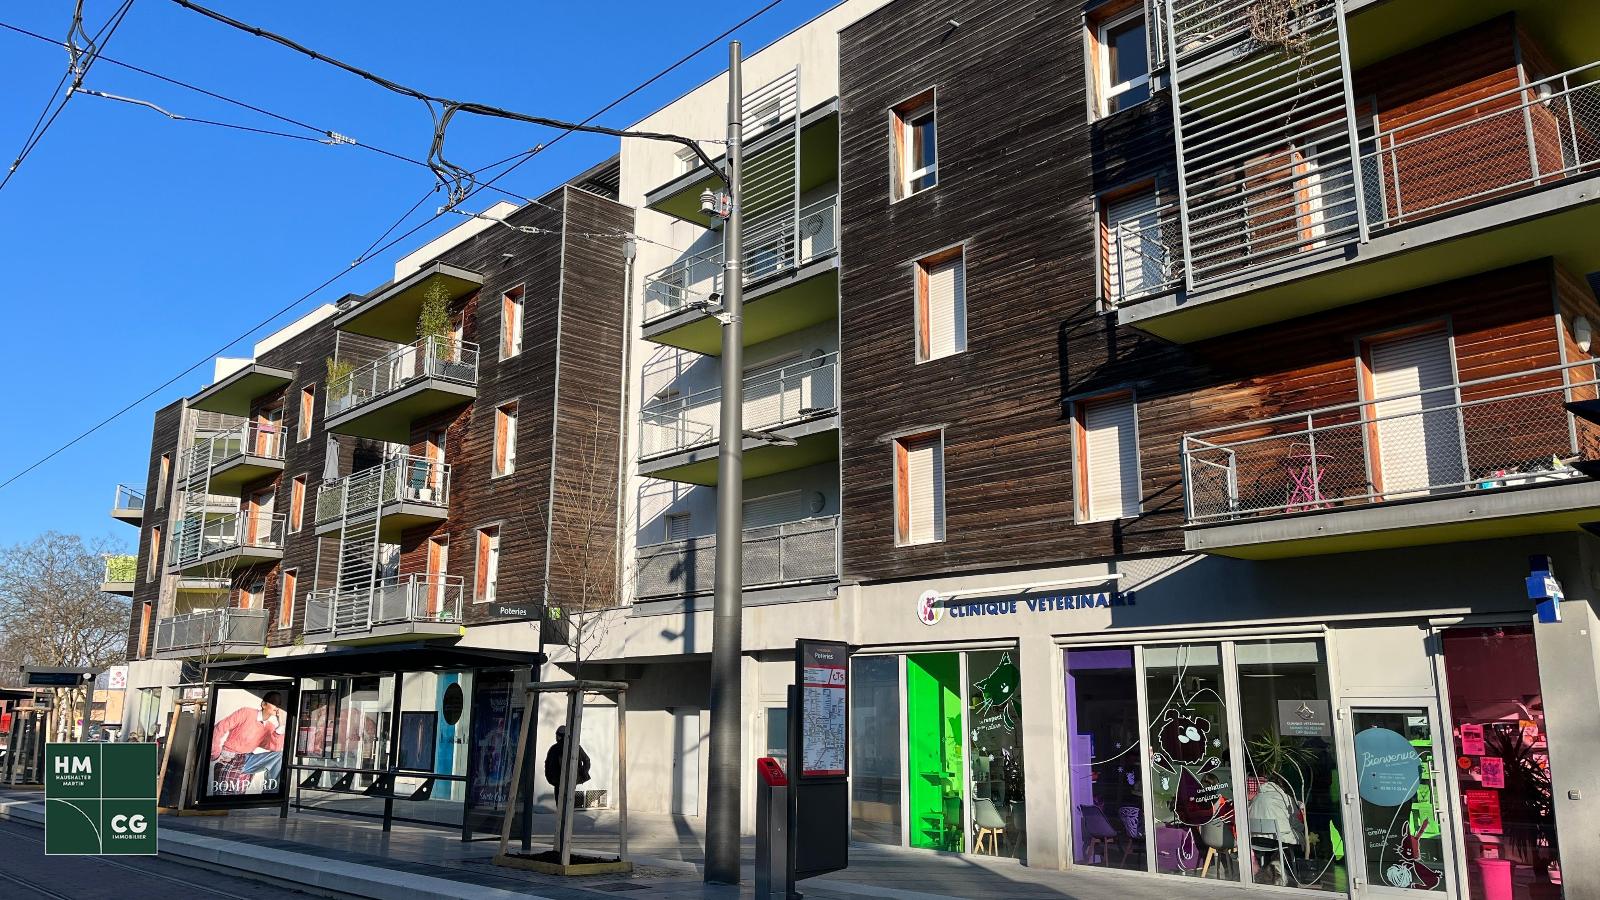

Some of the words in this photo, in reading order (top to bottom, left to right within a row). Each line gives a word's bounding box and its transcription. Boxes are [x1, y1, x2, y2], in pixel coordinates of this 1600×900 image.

[500, 606, 527, 616] Poteries
[950, 601, 1017, 618] CLINIQUE
[1361, 751, 1418, 768] Bienvenue
[211, 778, 278, 792] BOMPRD
